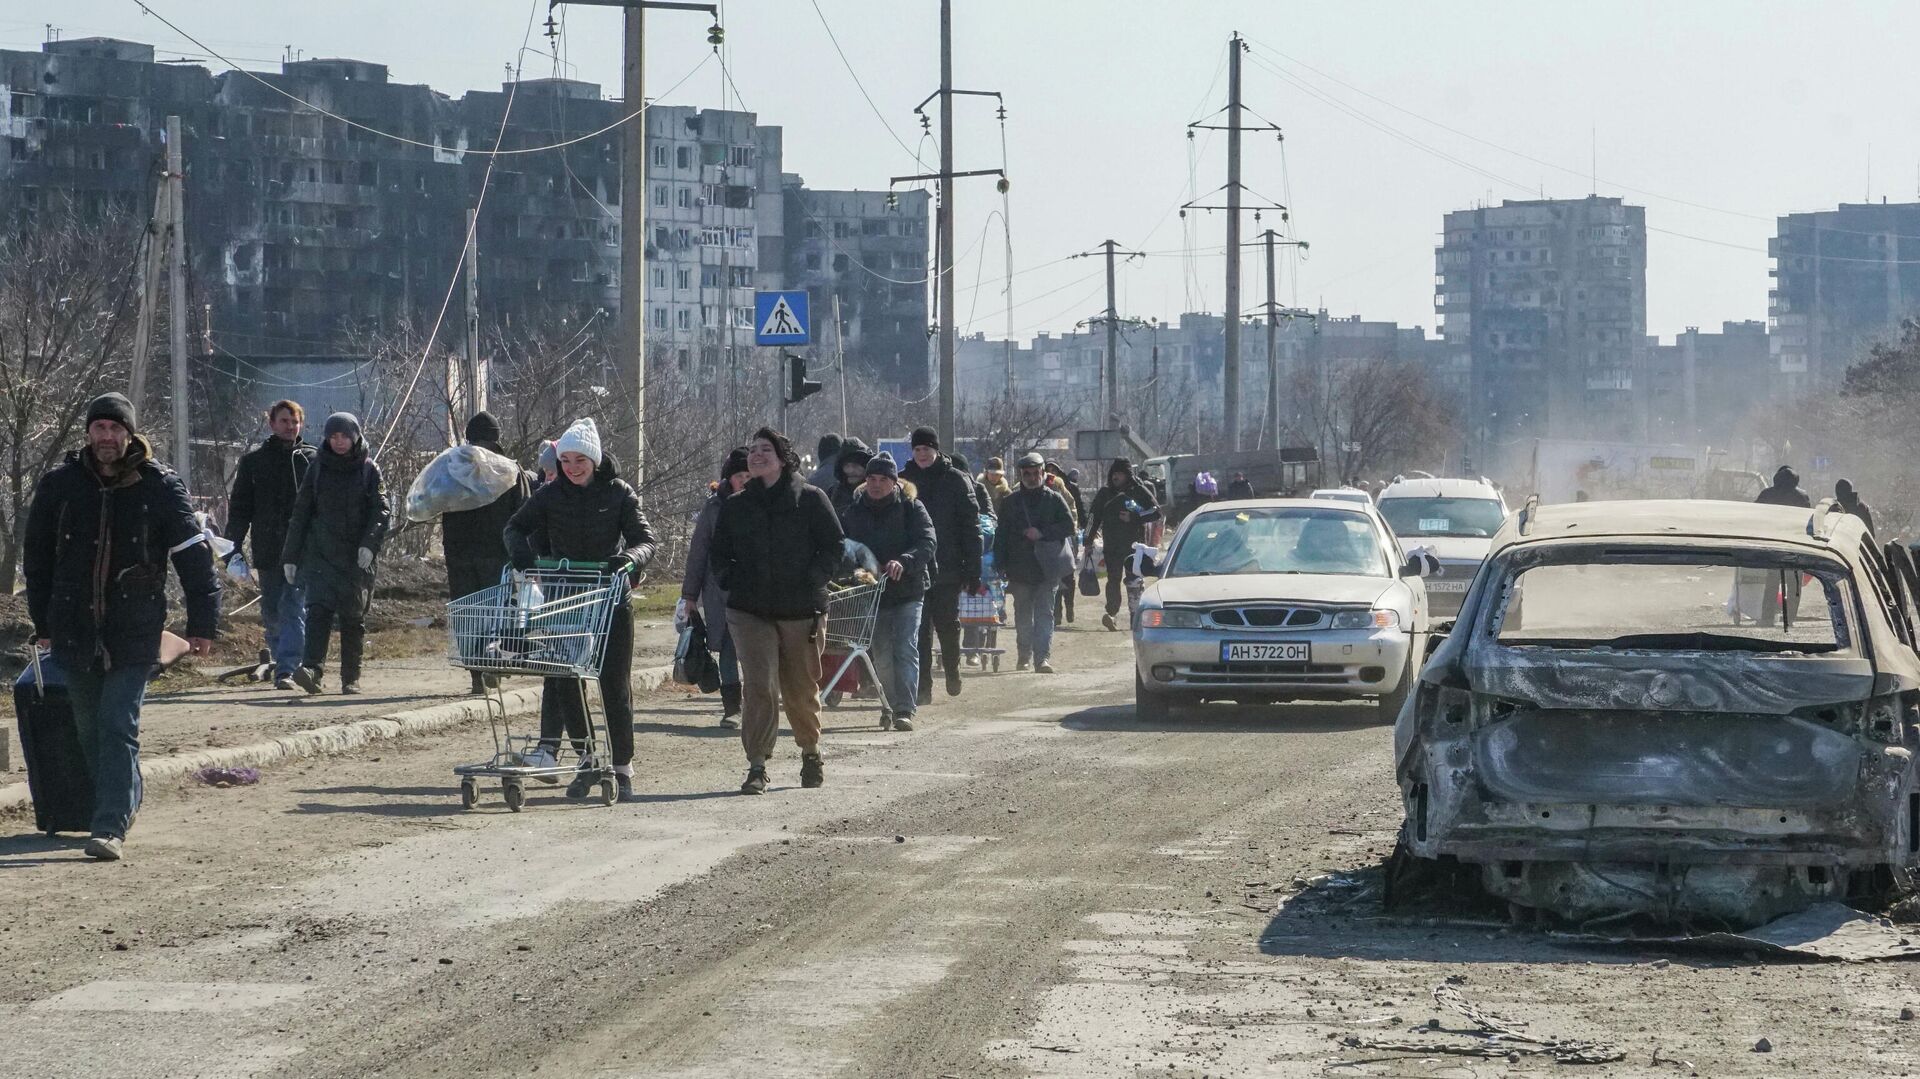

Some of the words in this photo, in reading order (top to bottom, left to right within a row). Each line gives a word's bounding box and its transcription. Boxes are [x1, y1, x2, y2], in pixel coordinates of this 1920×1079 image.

[1231, 646, 1250, 659] AH
[1253, 646, 1284, 659] 3722
[1286, 646, 1306, 659] OH
